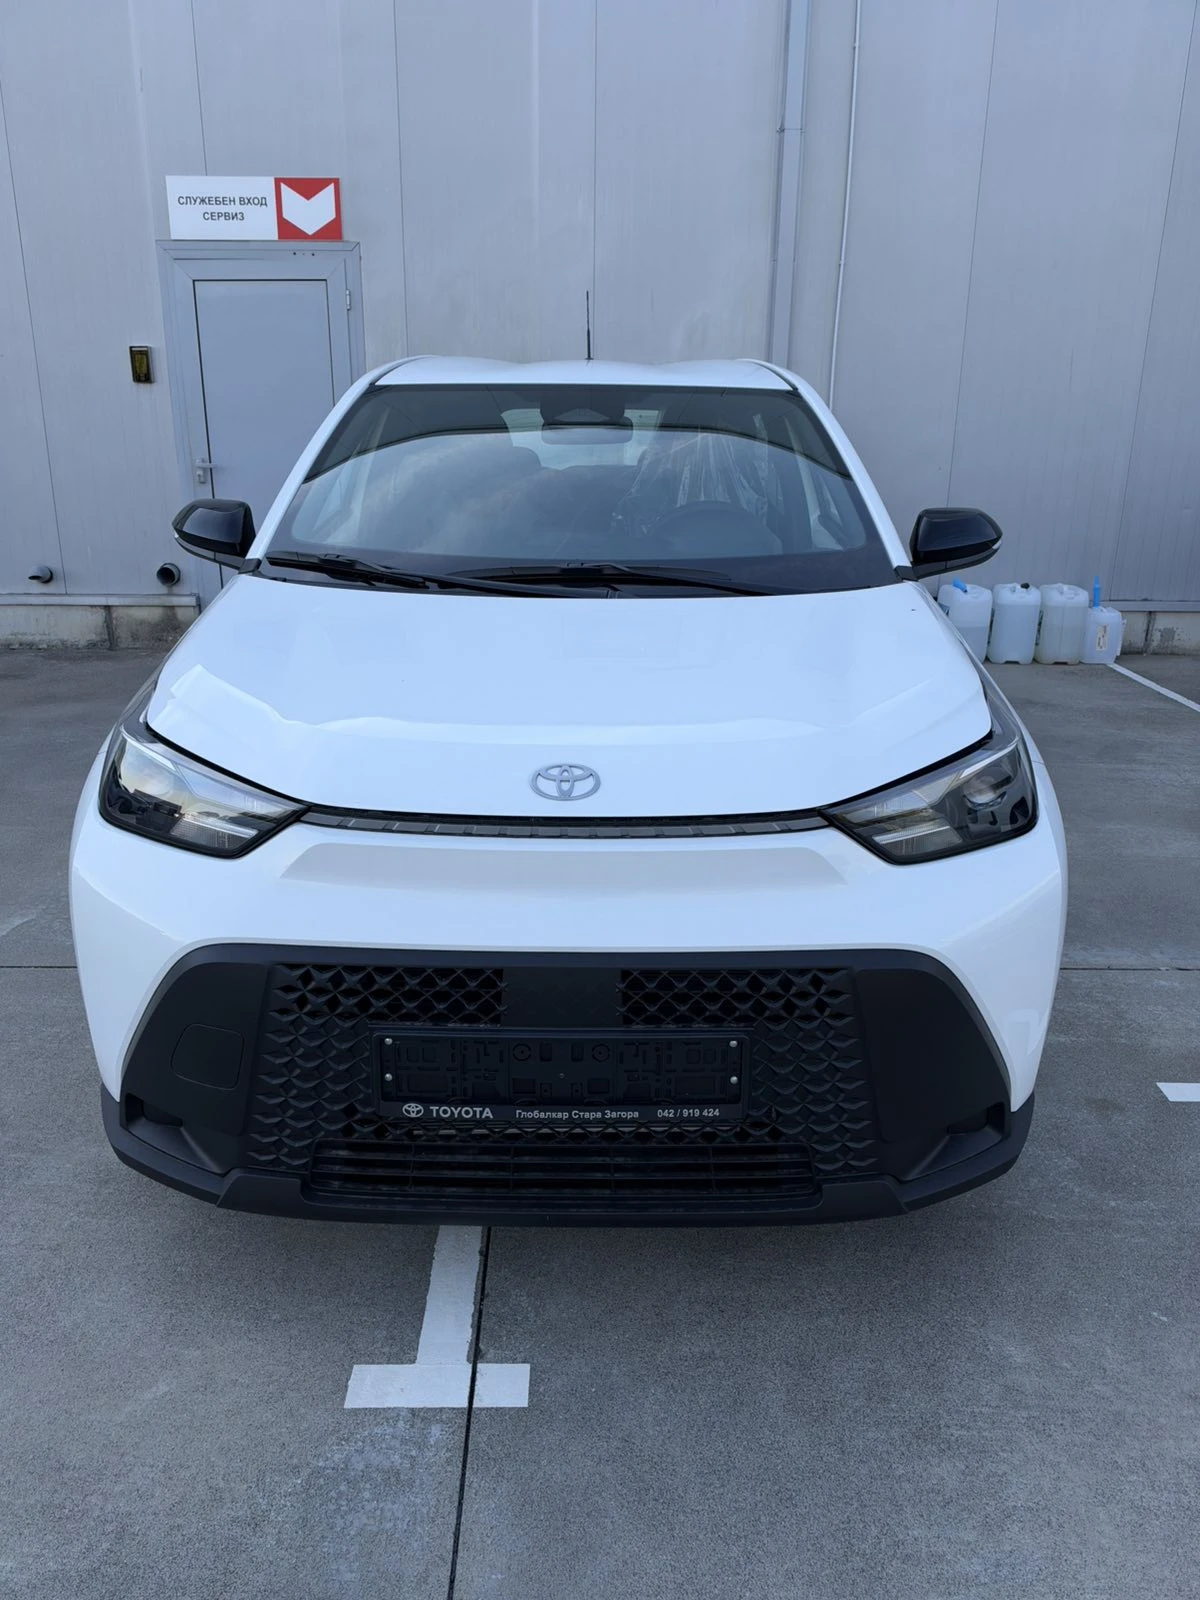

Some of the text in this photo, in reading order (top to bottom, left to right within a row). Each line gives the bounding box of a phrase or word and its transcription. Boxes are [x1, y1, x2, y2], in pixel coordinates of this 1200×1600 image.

[177, 196, 268, 207] СЛУЖЕБЕН ВХОД
[202, 211, 245, 221] СЕРВИЗ
[429, 1106, 494, 1119] TOYOTA
[515, 1109, 639, 1120] Глобалкар Стара Загора
[657, 1109, 675, 1118] 042
[682, 1109, 700, 1117] 919
[702, 1108, 720, 1117] 424
